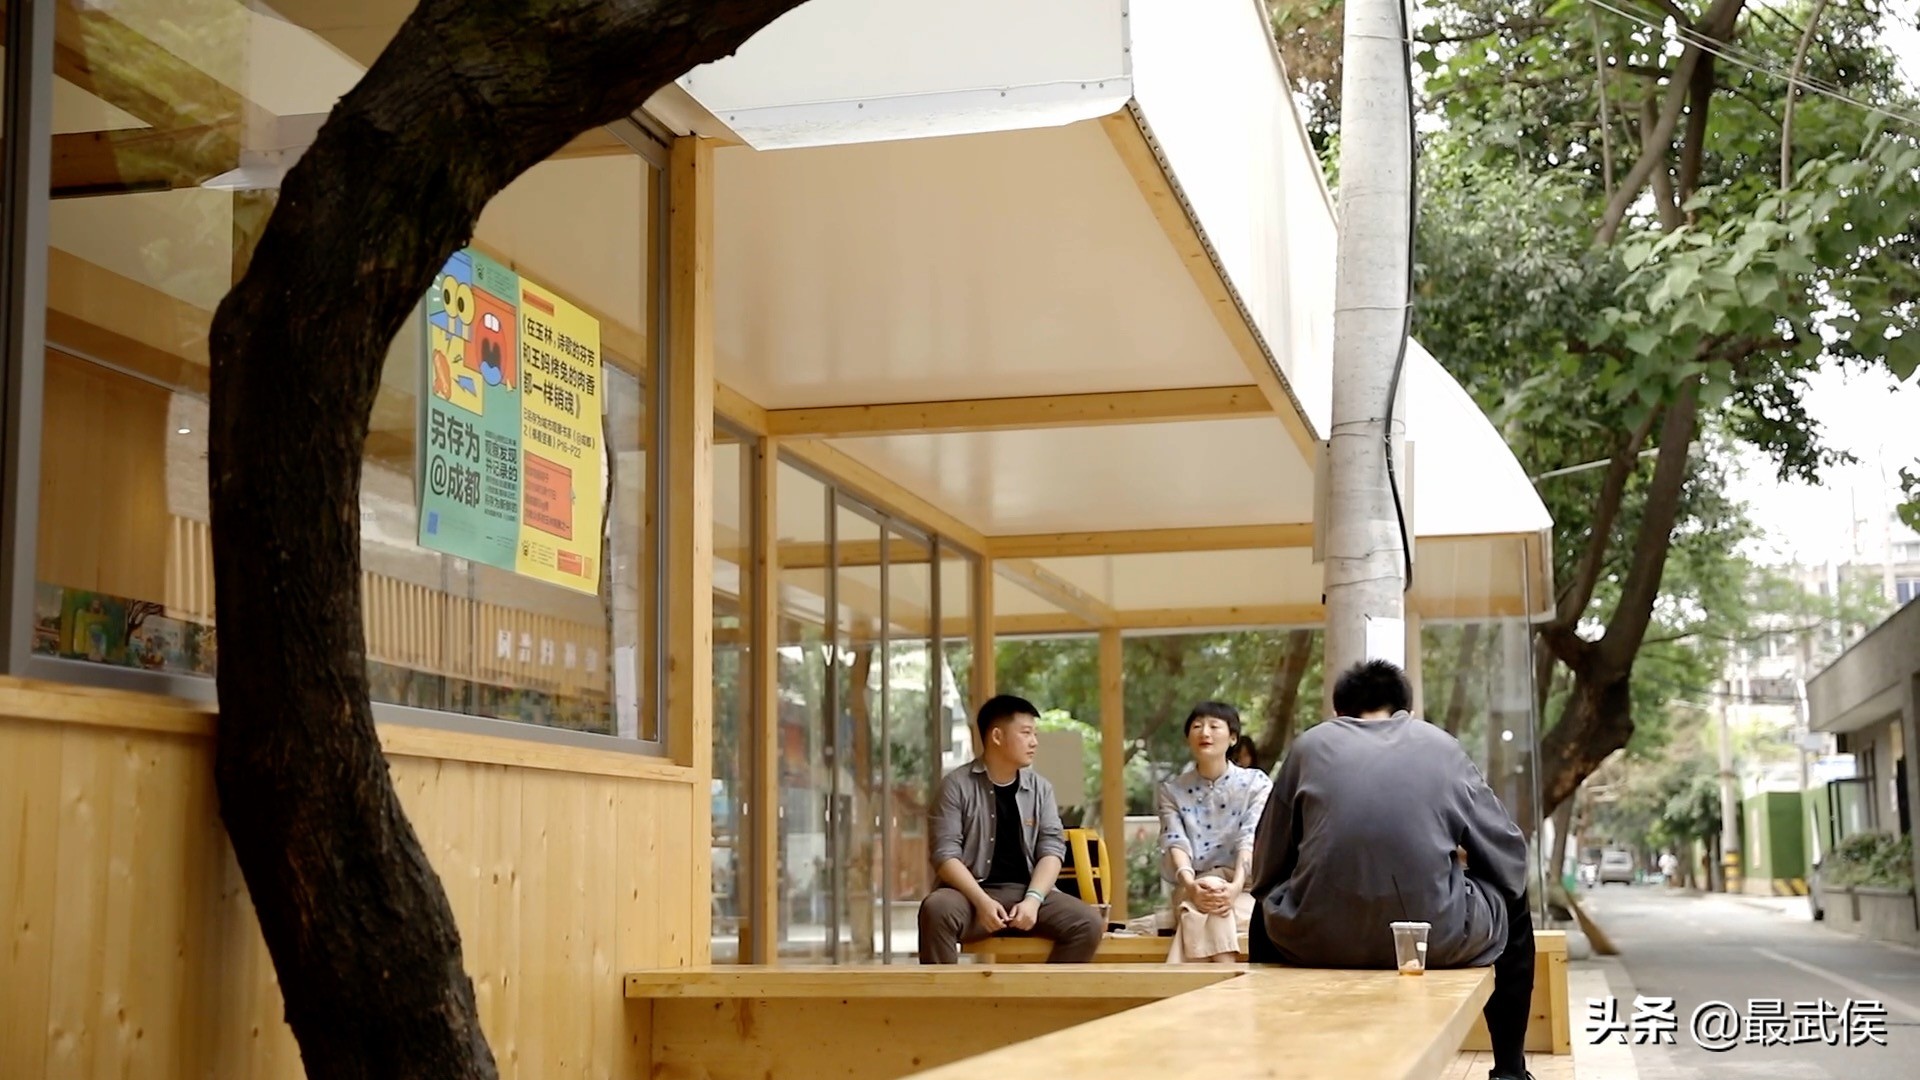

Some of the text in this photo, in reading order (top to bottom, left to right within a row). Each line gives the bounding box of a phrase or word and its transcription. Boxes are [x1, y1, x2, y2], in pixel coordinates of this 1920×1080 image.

[431, 408, 480, 464] 另存为
[430, 454, 480, 509] @成都
